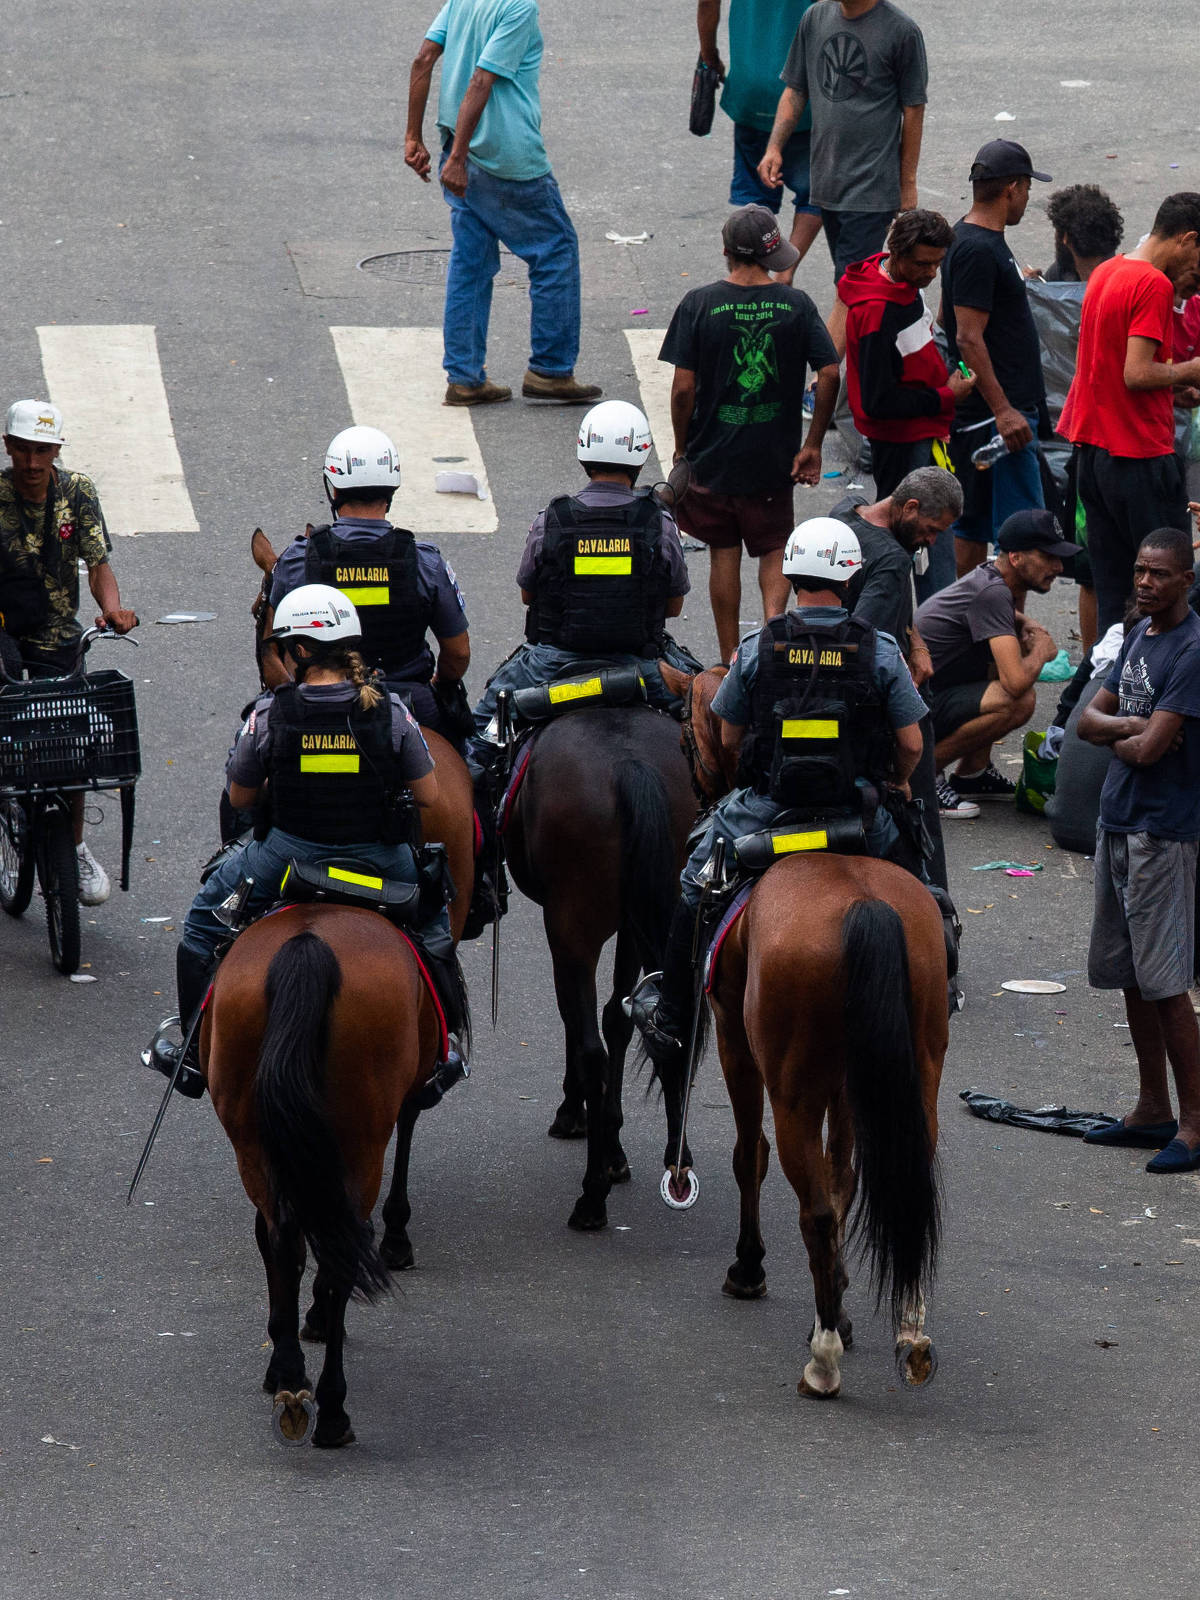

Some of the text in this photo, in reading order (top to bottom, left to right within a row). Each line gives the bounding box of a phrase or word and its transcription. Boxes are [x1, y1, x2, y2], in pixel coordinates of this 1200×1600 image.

[578, 538, 630, 553] CAVALARIA
[336, 567, 389, 582] CAVALARIA
[789, 648, 842, 667] CAVAARIA
[302, 734, 356, 749] CAVALARIA
